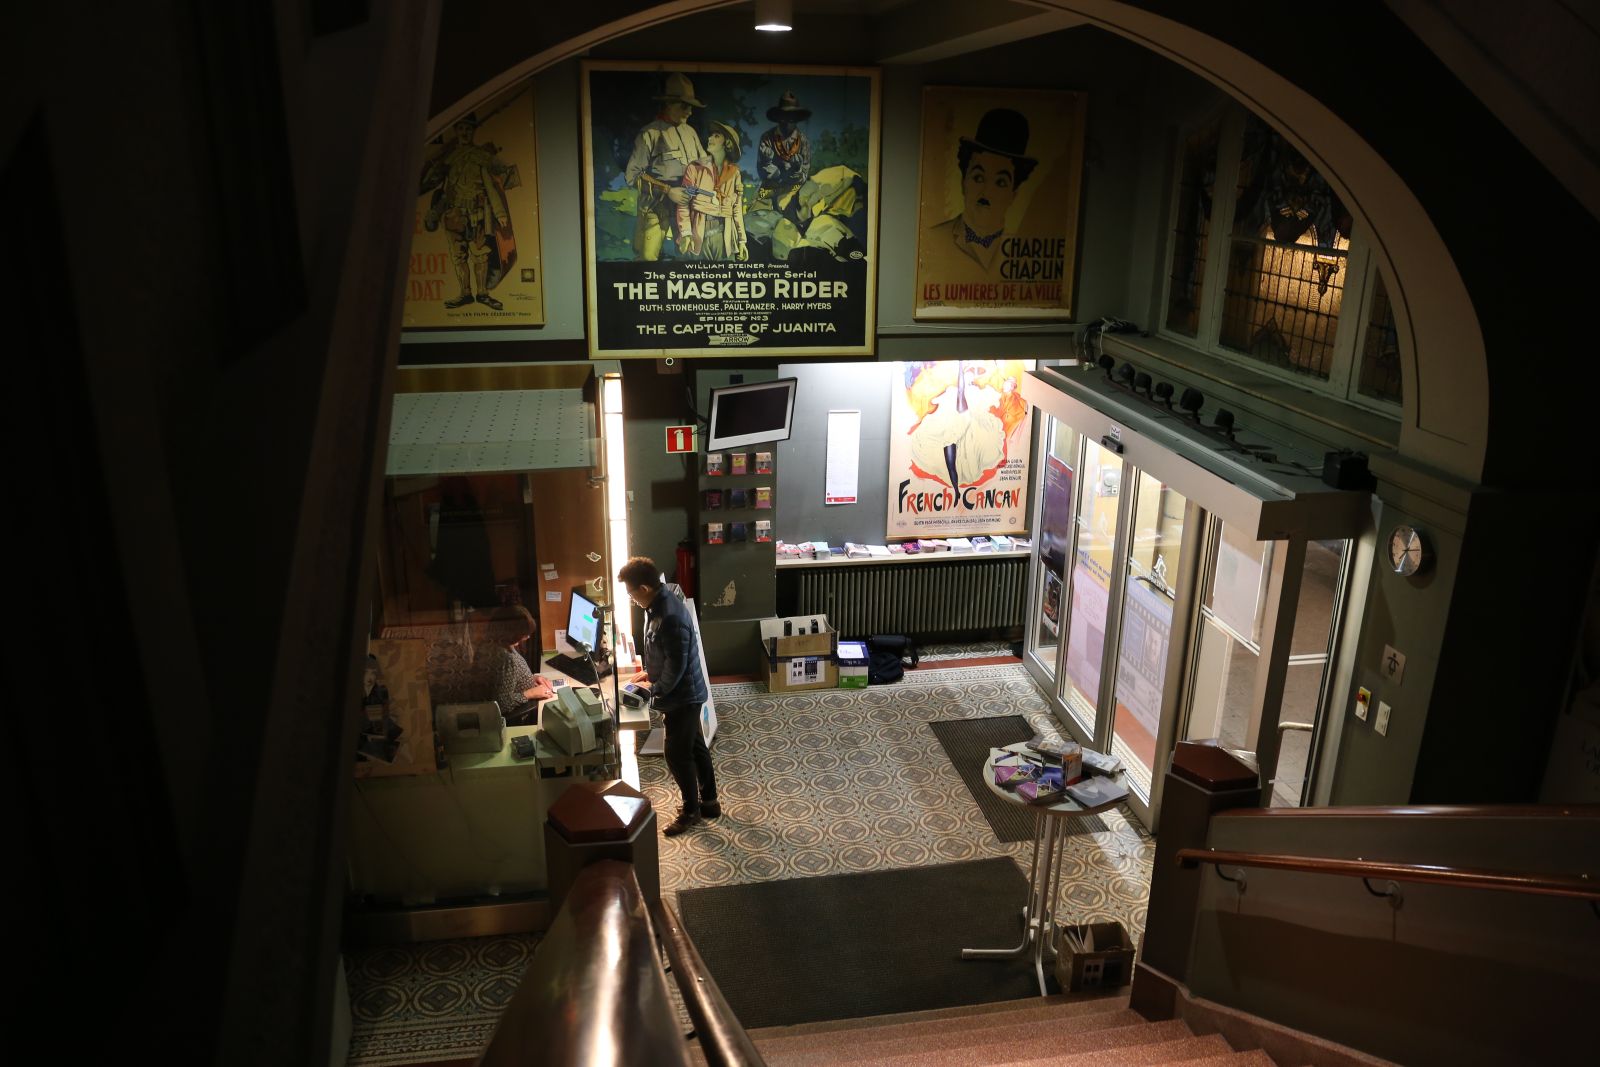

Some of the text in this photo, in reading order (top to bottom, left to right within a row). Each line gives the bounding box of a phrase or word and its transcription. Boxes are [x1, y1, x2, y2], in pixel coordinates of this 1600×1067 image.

[1001, 238, 1066, 258] CHARLIE
[644, 270, 817, 280] The Sensational Western Serial
[1000, 260, 1064, 280] CHAPLIN
[613, 278, 848, 300] THE MASKED RIDER
[923, 283, 1063, 301] LES LUMIERES DE LA VILLE
[639, 303, 663, 312] RUTH
[724, 303, 744, 311] PAUL
[781, 302, 805, 311] HARRY
[806, 302, 832, 310] MYERS
[636, 322, 837, 335] THE CAPTURE OF JUANITA
[962, 487, 1020, 511] CANCAN
